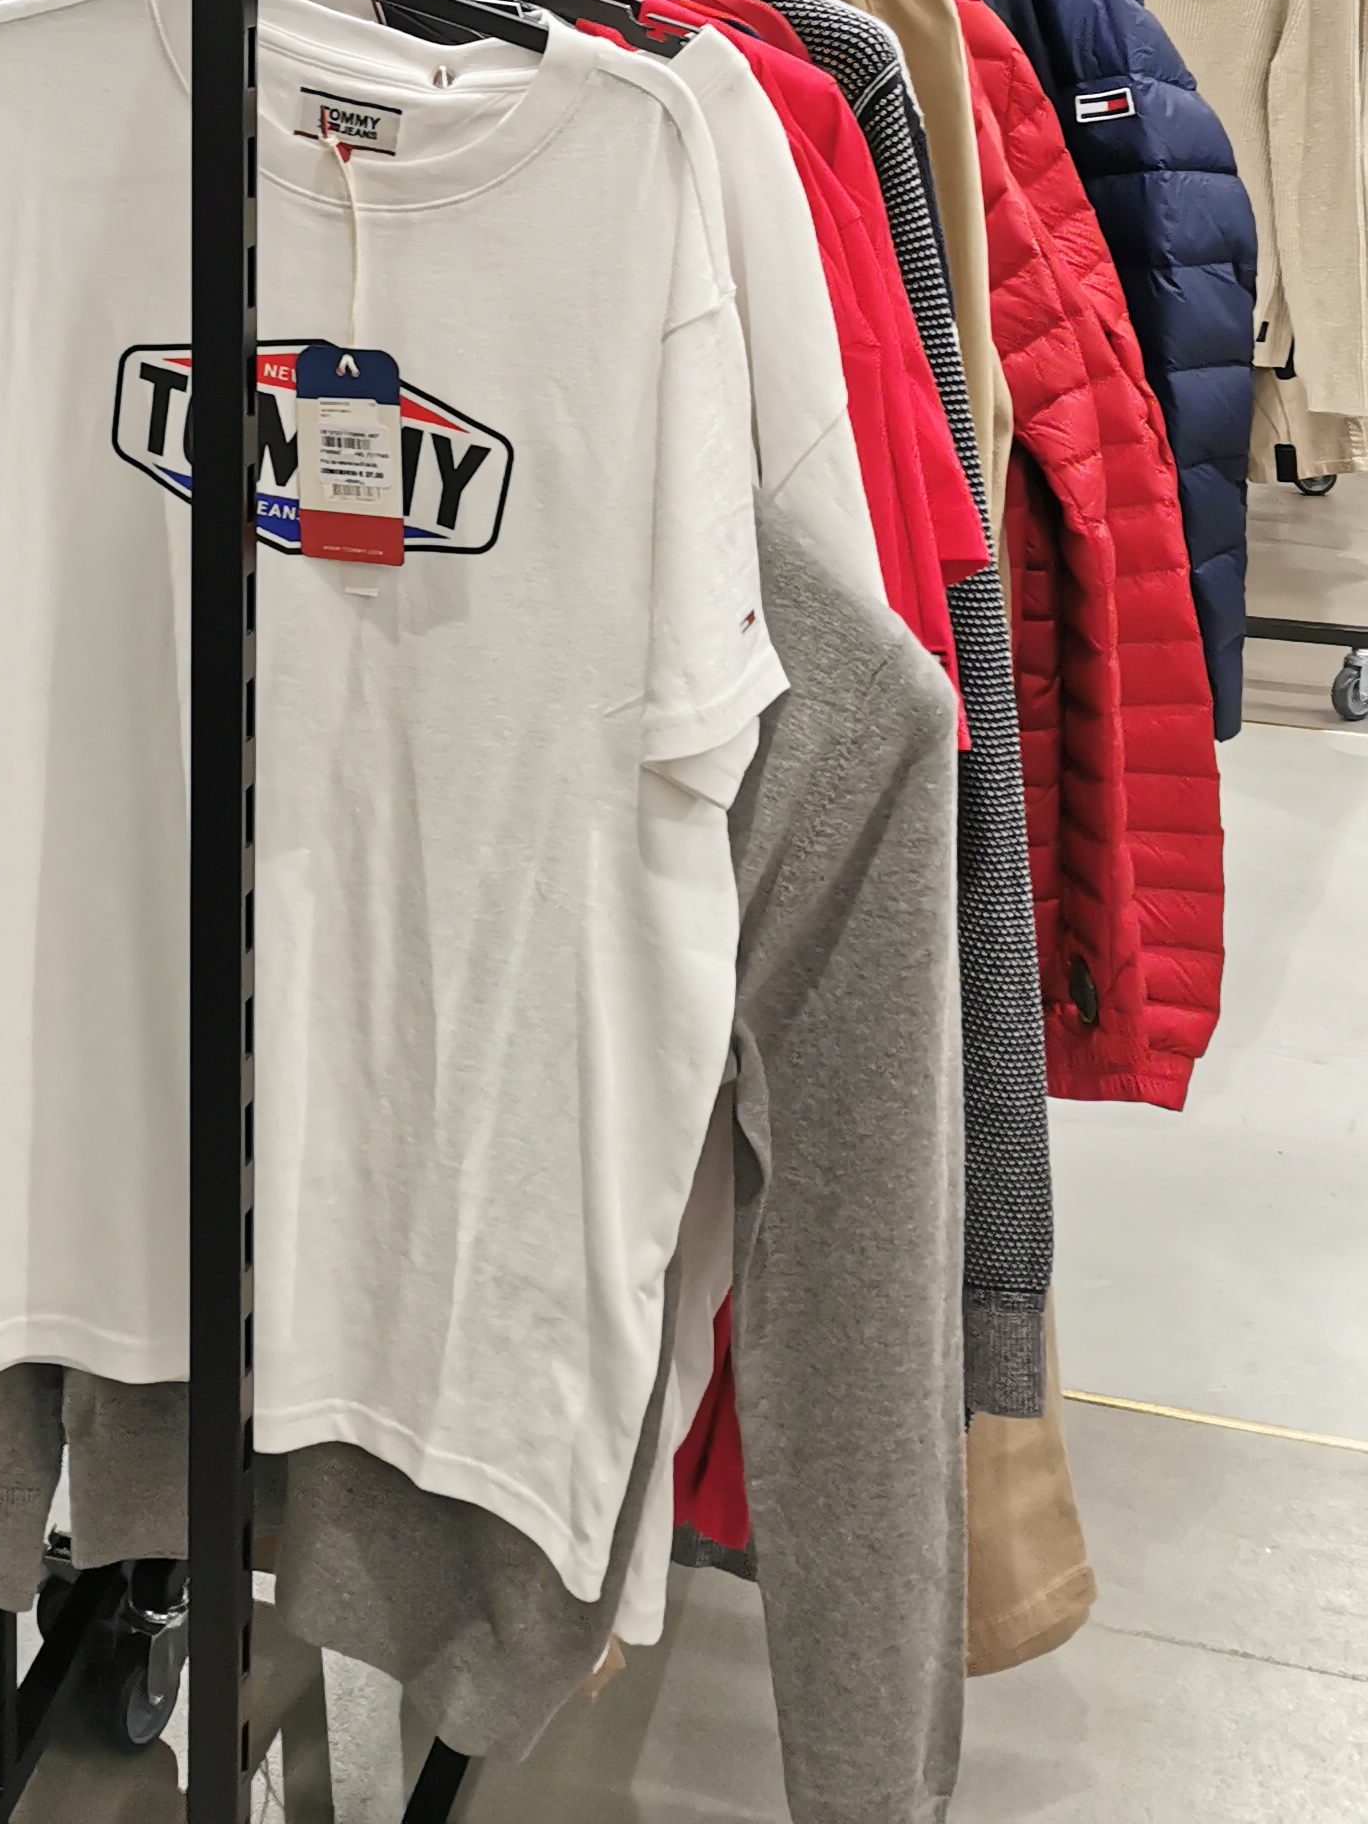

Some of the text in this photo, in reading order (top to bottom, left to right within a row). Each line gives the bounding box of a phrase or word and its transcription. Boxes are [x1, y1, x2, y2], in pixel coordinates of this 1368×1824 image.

[341, 125, 377, 140] JEANS
[263, 362, 296, 382] NE
[256, 501, 298, 522] EAN
